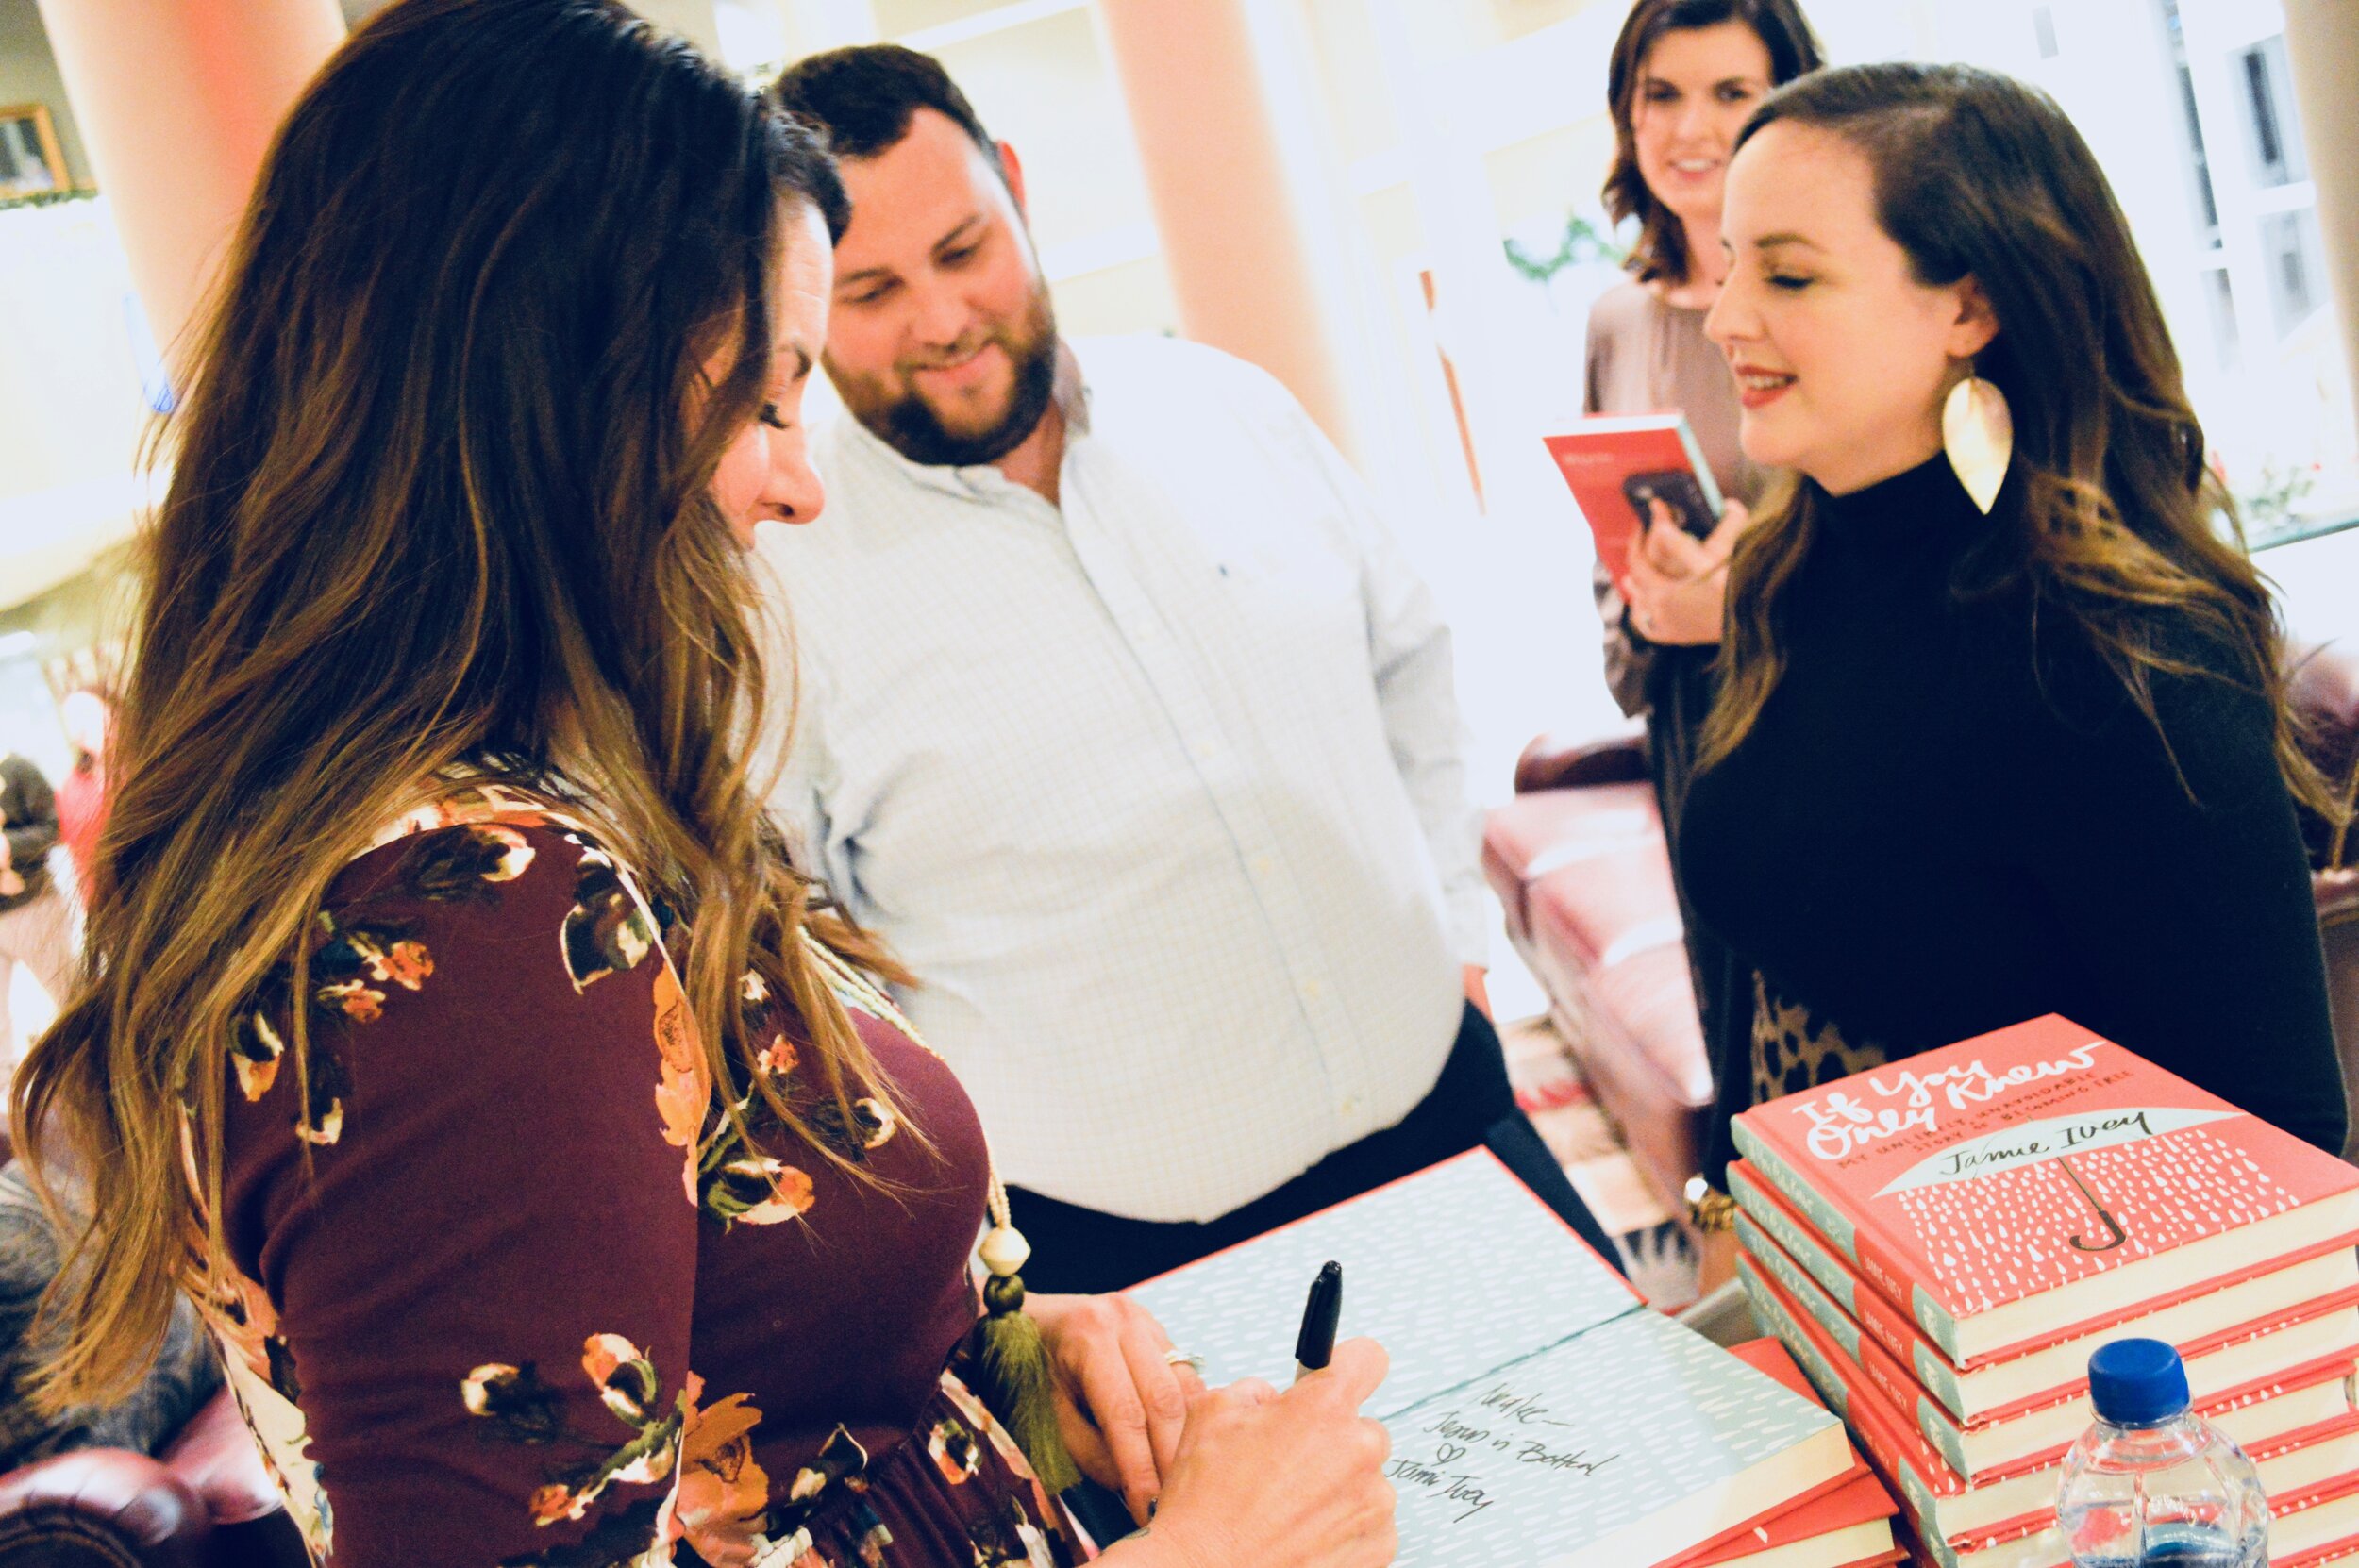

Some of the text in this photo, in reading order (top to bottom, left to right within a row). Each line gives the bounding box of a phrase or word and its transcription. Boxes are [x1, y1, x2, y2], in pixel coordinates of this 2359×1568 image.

[1792, 1059, 1992, 1126] If You
[1807, 1040, 2108, 1160] Only Knew
[1939, 1111, 2154, 1179] Jamie Ivey
